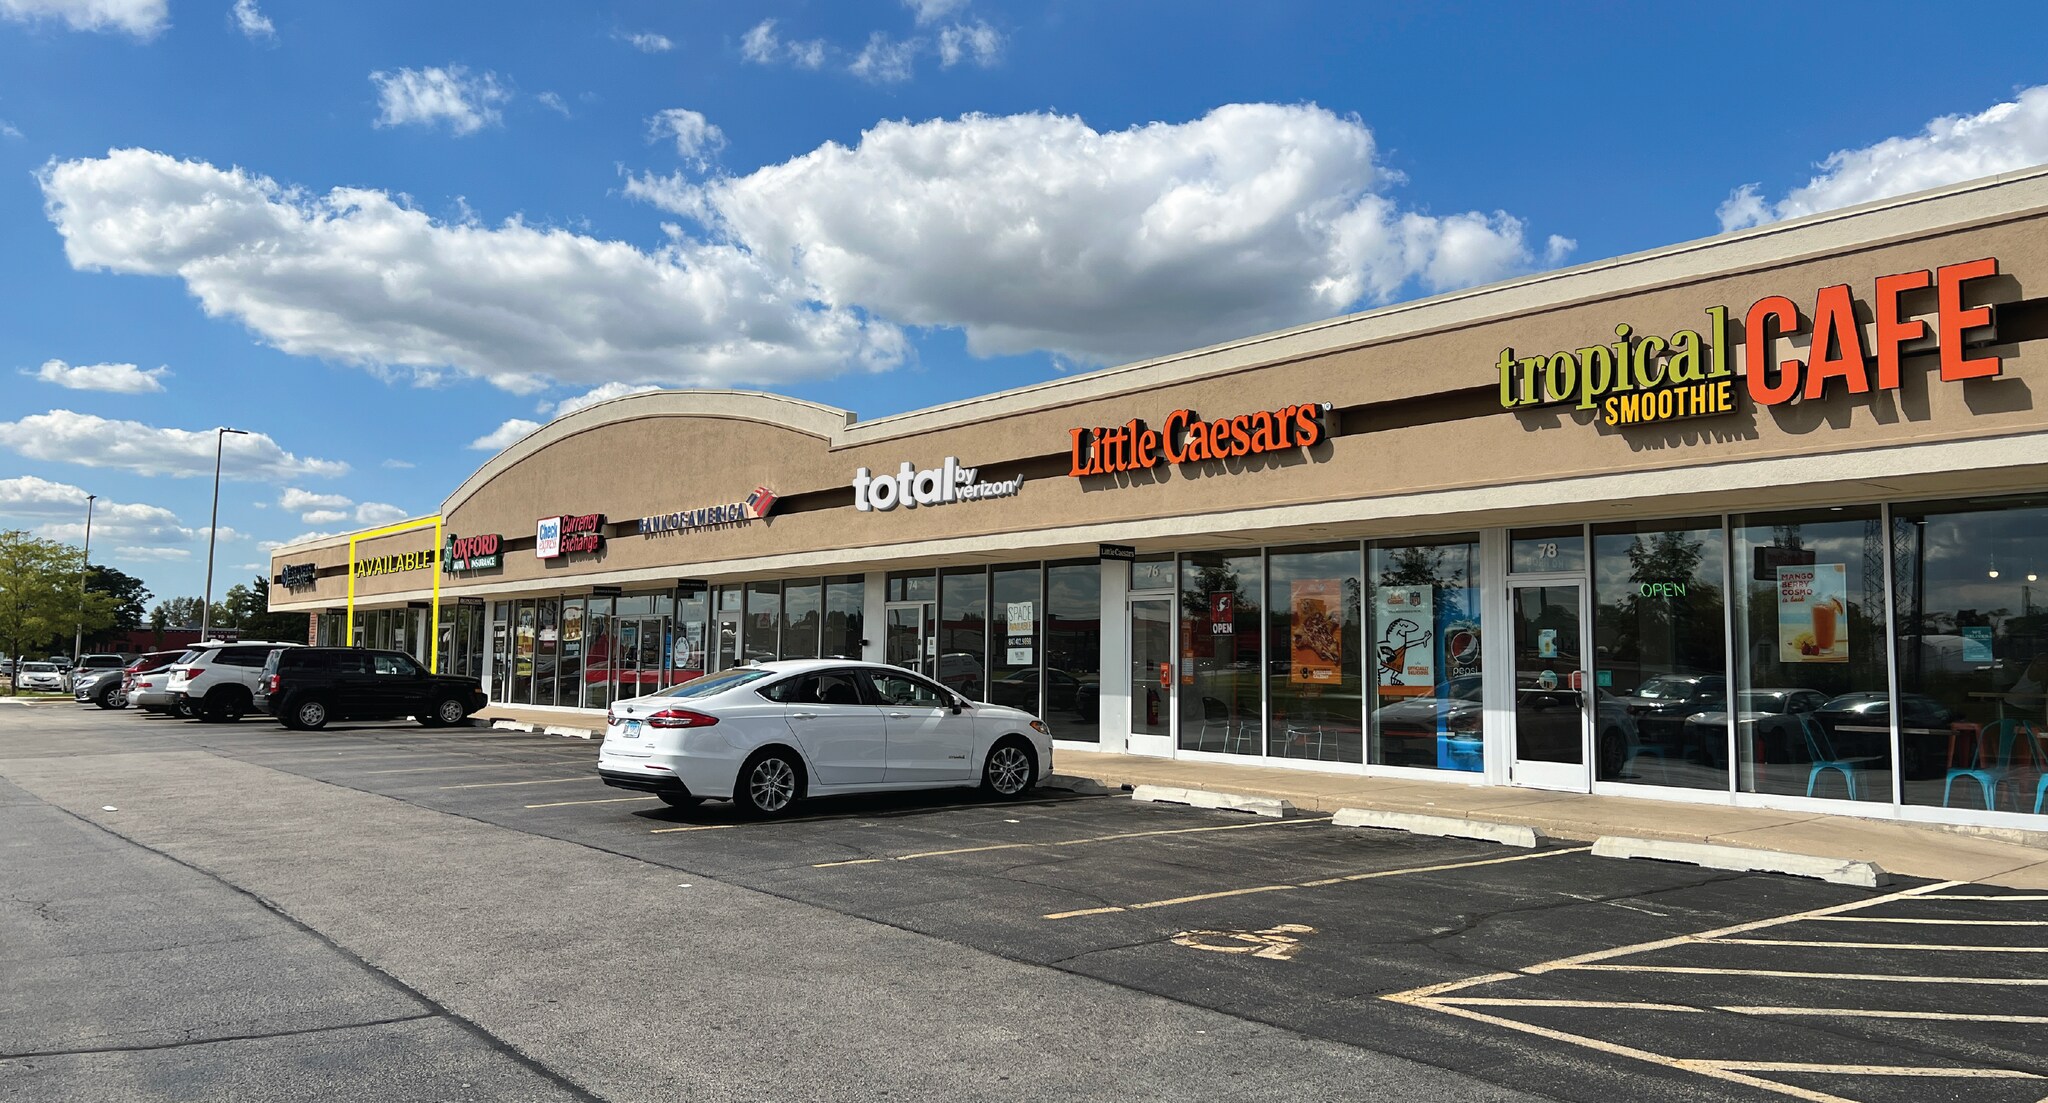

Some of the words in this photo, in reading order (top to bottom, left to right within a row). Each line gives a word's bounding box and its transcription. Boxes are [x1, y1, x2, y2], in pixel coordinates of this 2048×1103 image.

[1745, 257, 2002, 406] CAFE
[1496, 305, 1732, 411] tropical
[1604, 380, 1733, 427] SMOOTHIE
[1068, 418, 1157, 478] Little
[1163, 403, 1319, 465] Caesars
[852, 456, 957, 511] total
[955, 465, 977, 485] by
[955, 479, 1014, 499] verizon
[561, 514, 599, 534] Currency
[638, 515, 668, 533] BANK
[671, 512, 686, 528] OF
[688, 503, 745, 526] AMERICA
[540, 522, 558, 540] Check
[453, 533, 498, 569] OXFORD
[560, 535, 598, 553] Exchange
[1538, 543, 1557, 558] 78
[1146, 565, 1159, 578] 76
[908, 580, 918, 590] 74
[1640, 582, 1686, 597] OPEN
[1008, 606, 1031, 621] SPACE
[1212, 622, 1232, 634] OPEN
[1452, 665, 1478, 676] pepsi
